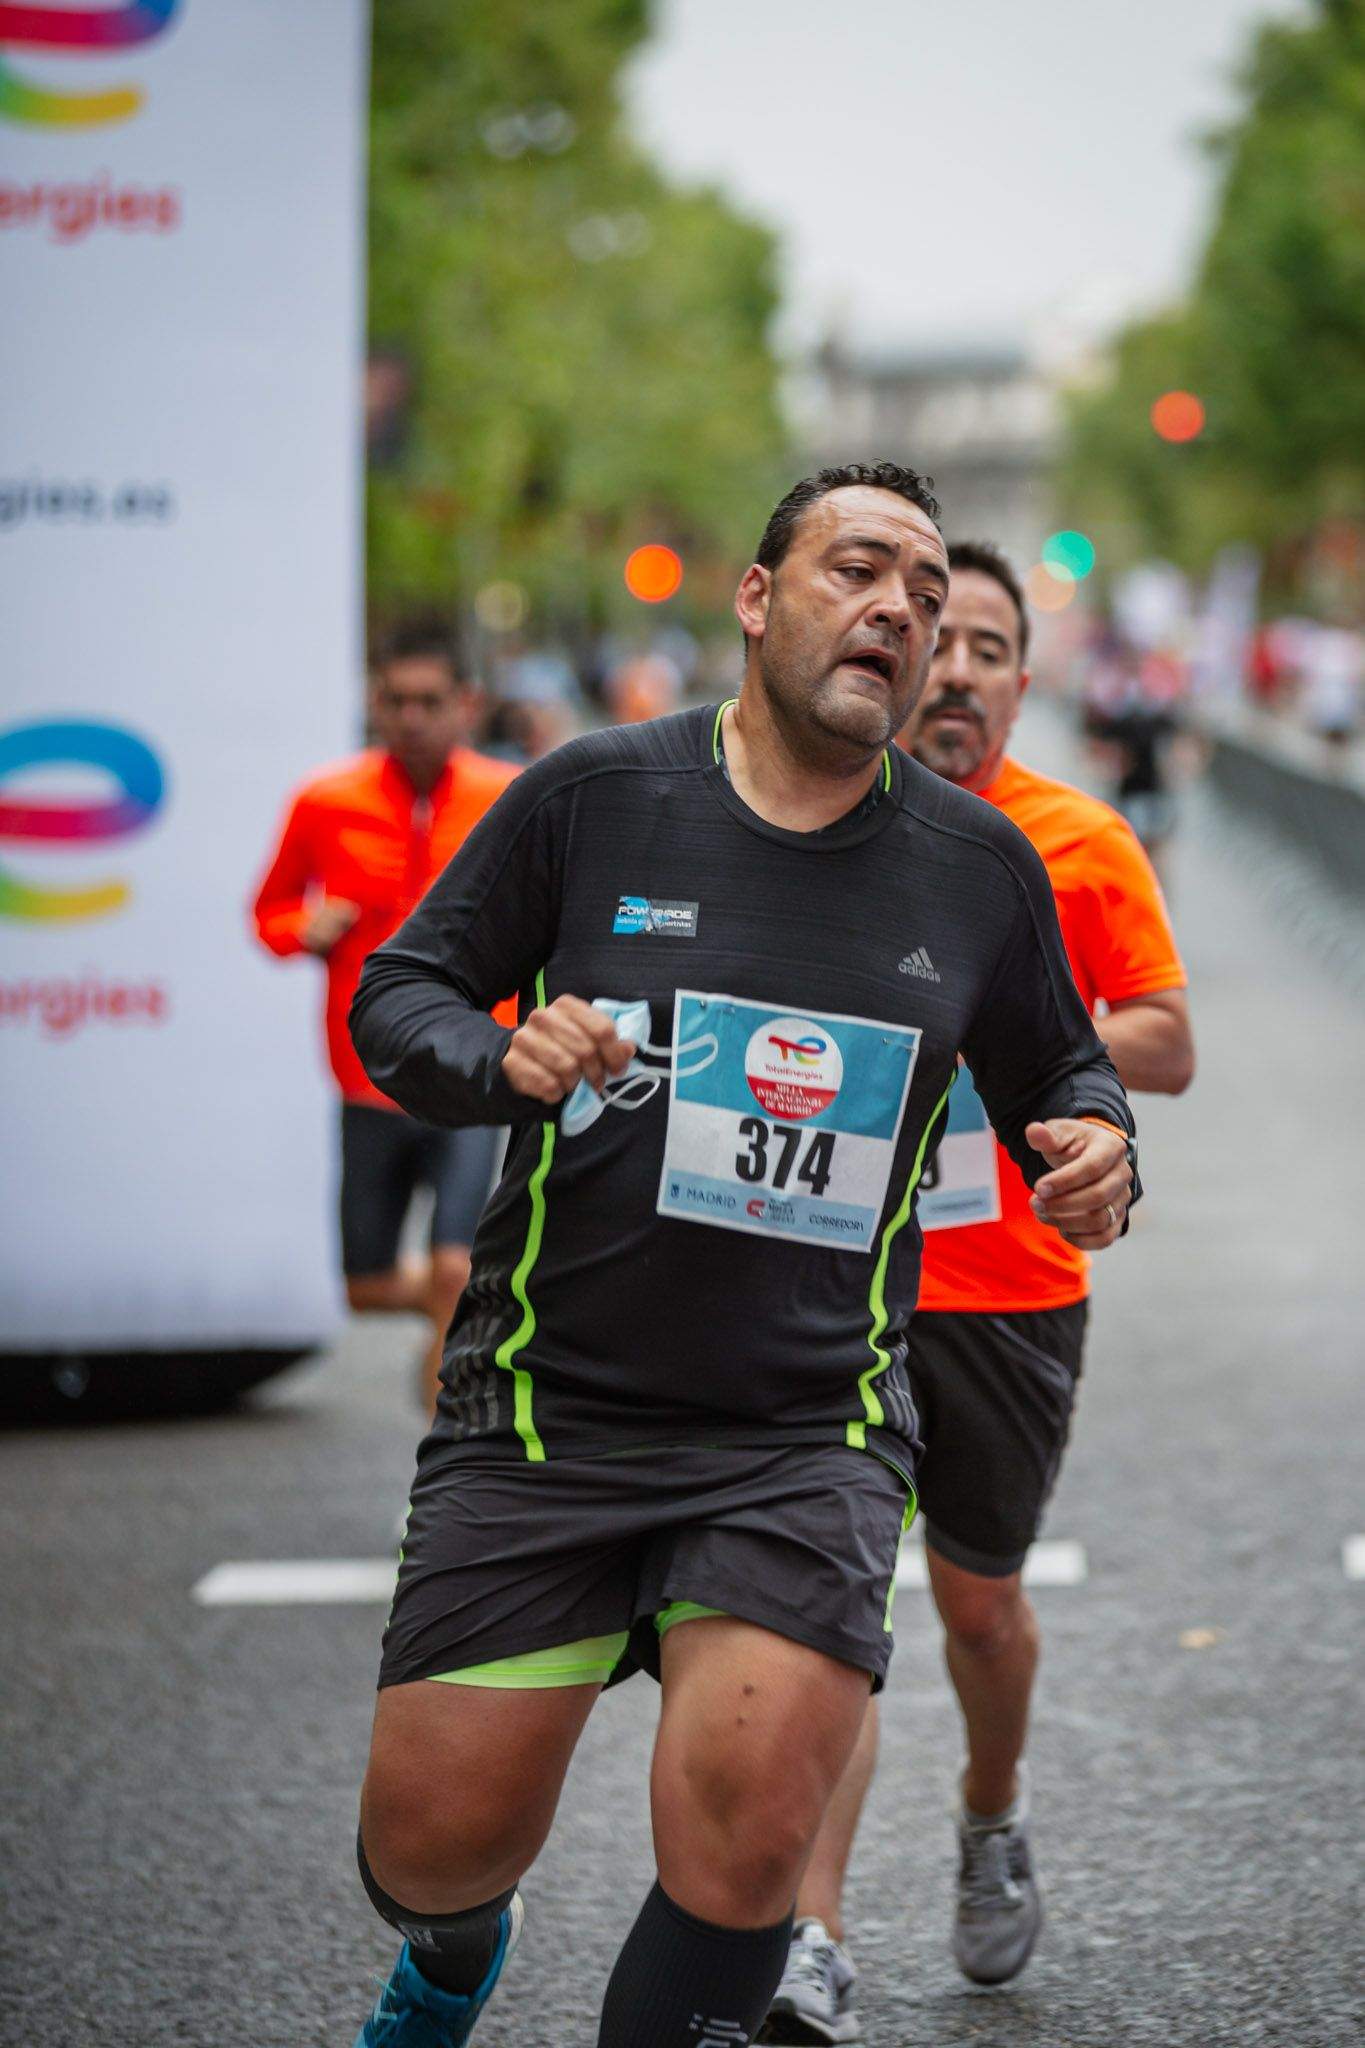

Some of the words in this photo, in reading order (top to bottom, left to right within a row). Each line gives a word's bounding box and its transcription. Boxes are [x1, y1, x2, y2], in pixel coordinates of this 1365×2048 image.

[898, 962, 941, 983] adidas
[735, 1117, 836, 1197] 374
[686, 1187, 736, 1209] MADRID
